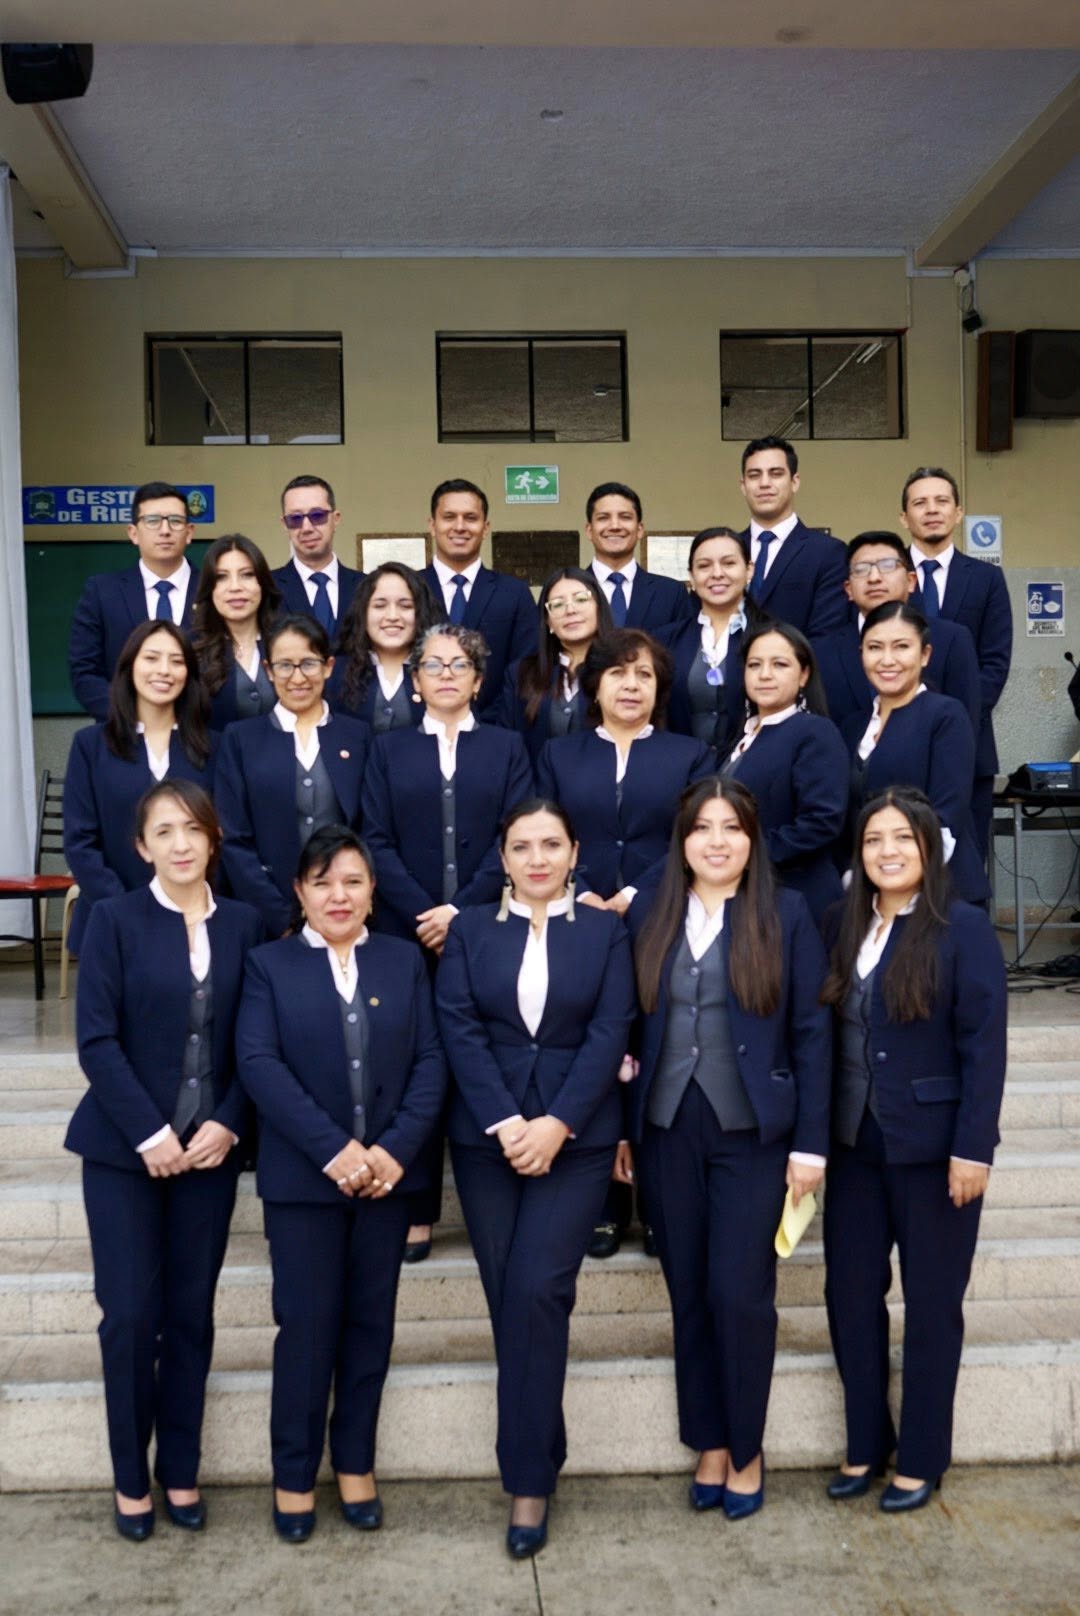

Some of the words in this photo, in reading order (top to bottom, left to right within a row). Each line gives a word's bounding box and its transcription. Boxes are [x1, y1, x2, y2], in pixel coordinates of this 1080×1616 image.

[67, 488, 136, 505] GESTI
[58, 510, 82, 522] DE
[91, 505, 132, 522] RIE
